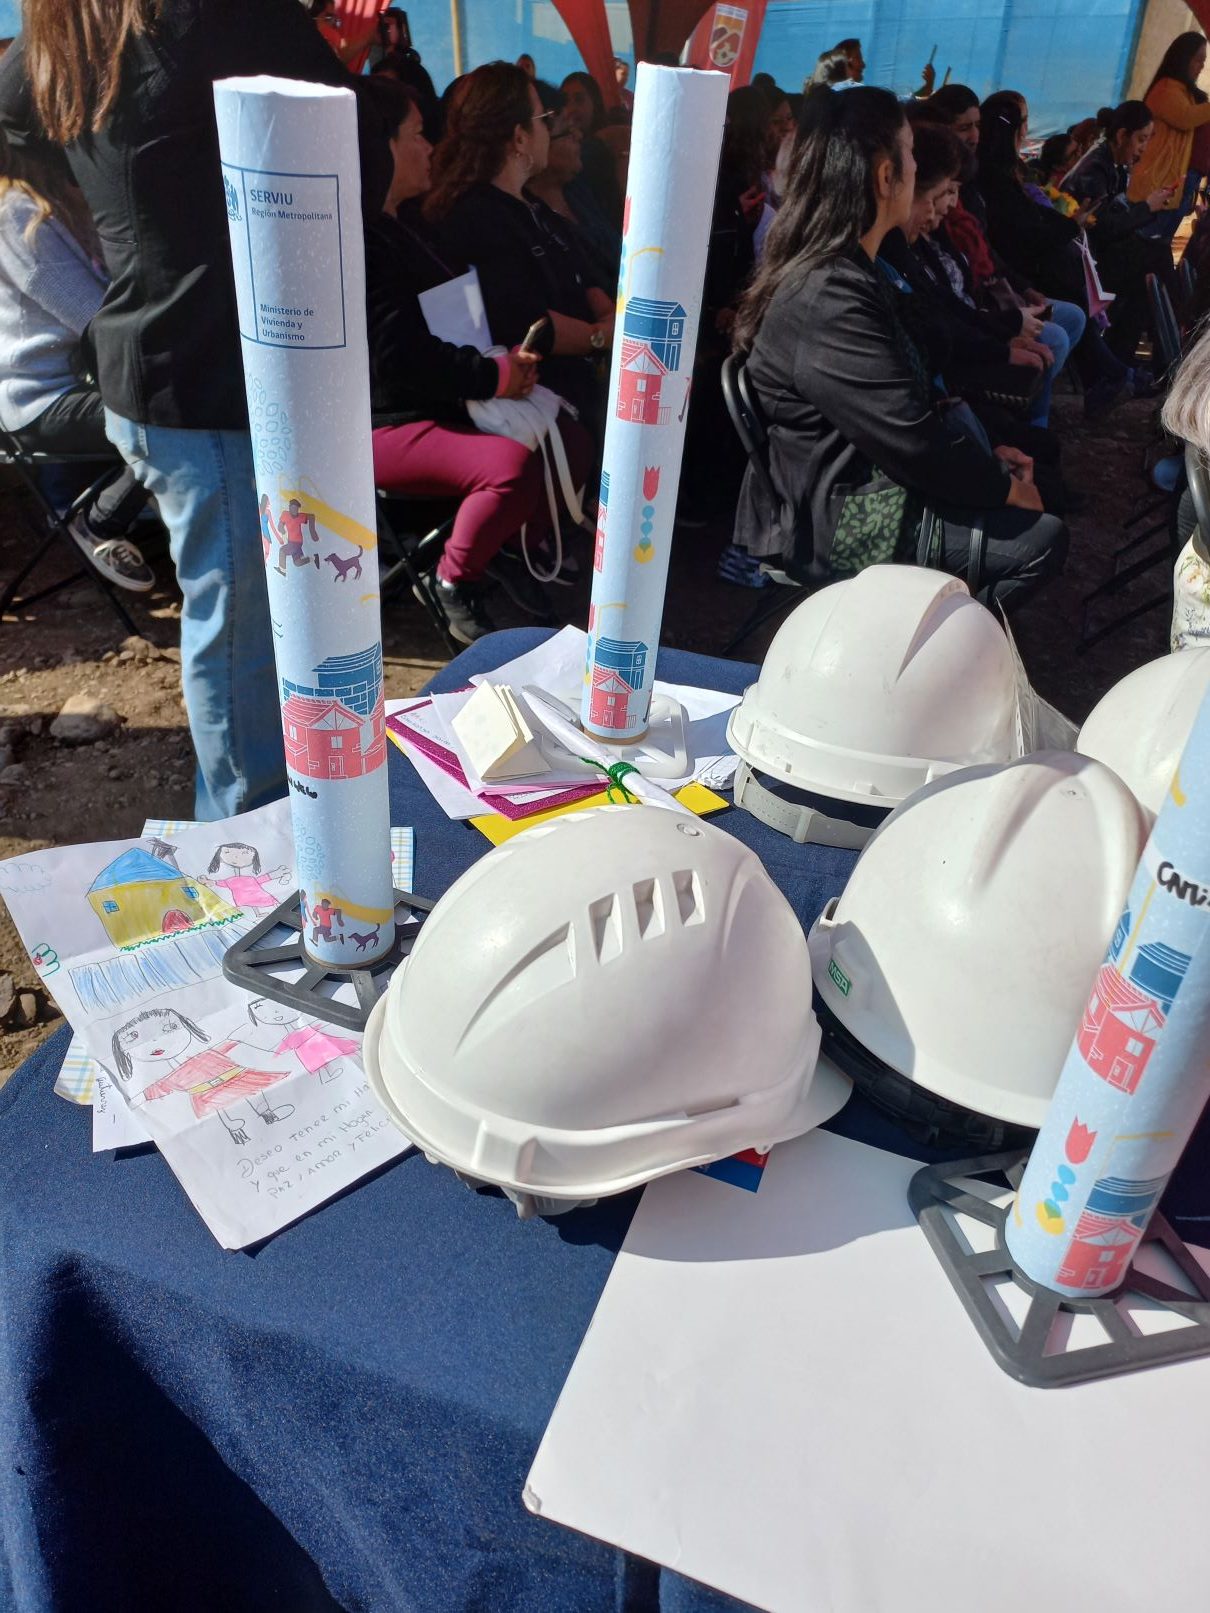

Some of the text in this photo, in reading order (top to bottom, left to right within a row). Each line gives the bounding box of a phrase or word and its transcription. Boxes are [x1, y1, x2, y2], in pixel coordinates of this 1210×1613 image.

[250, 189, 293, 206] SERVIU
[251, 208, 333, 221] Región Metropolitana
[260, 303, 315, 317] Ministerio de
[261, 316, 303, 331] Vivienda y
[262, 328, 305, 342] Urbanismo
[829, 960, 849, 996] MSA
